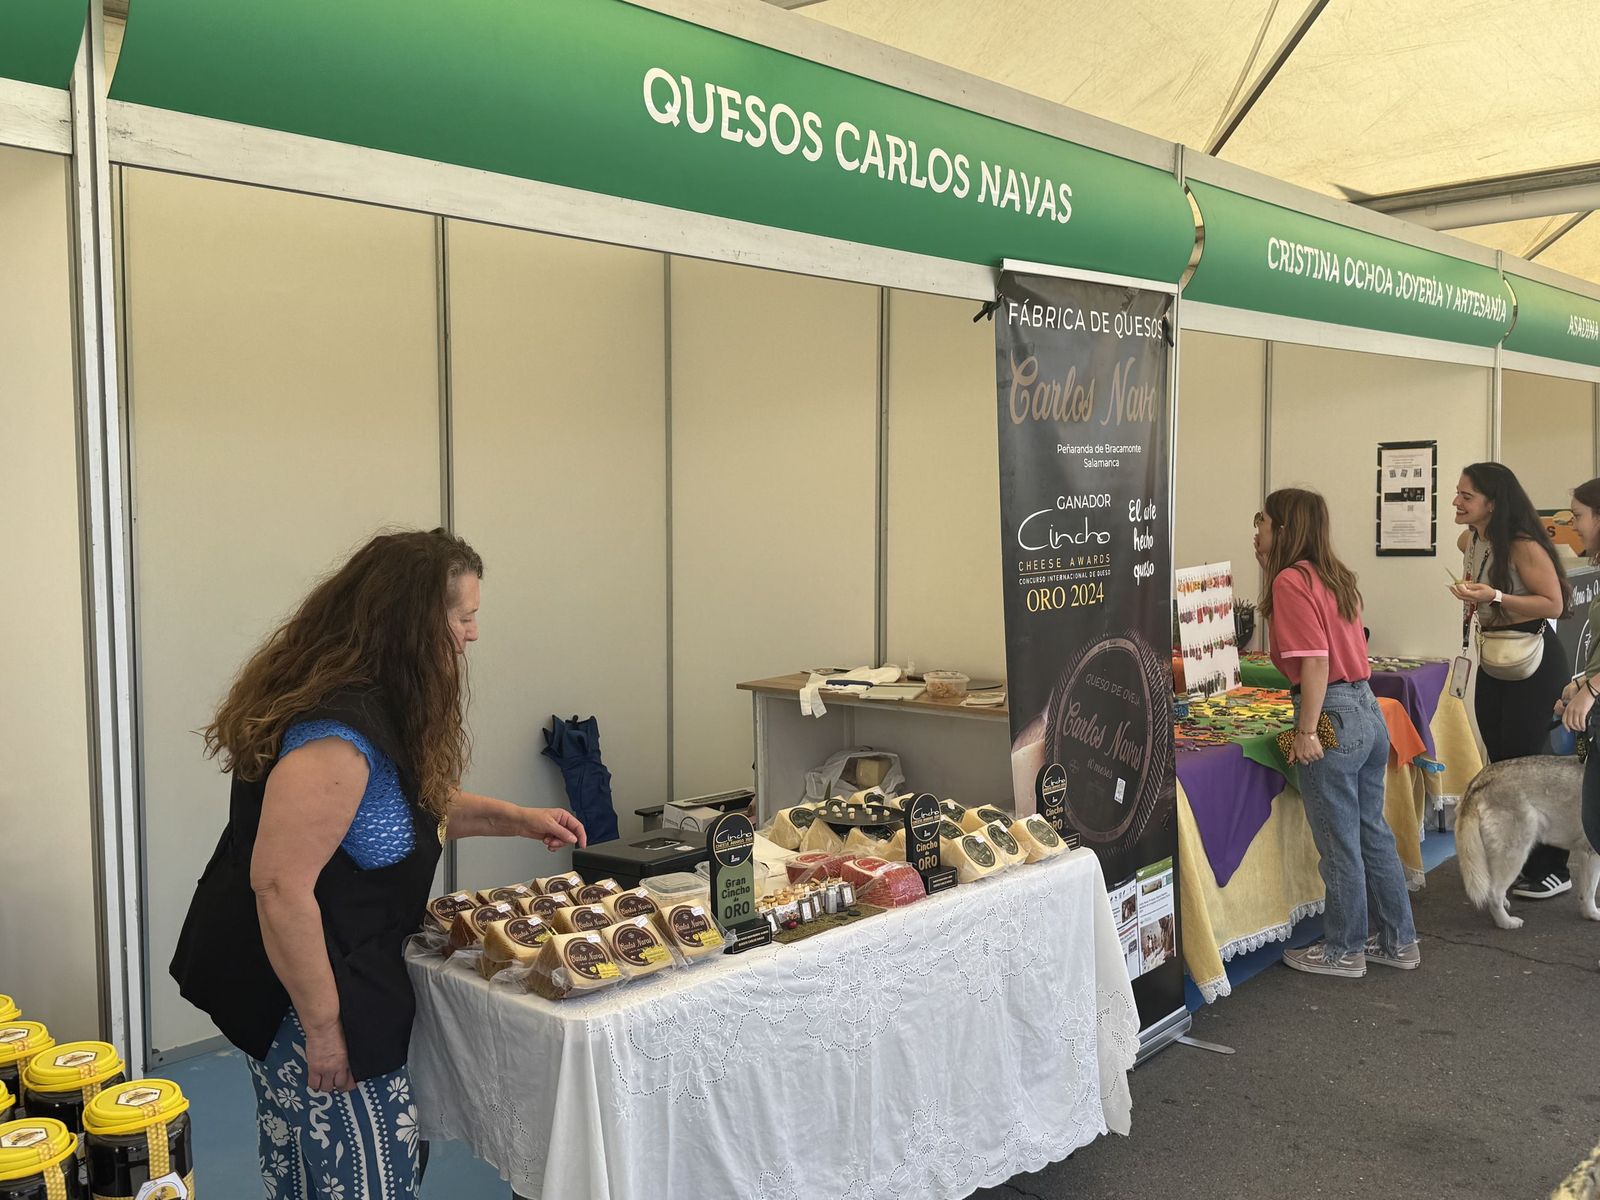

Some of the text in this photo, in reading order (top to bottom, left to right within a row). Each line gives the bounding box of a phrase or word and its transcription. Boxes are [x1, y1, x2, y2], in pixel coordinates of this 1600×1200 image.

[643, 67, 1073, 223] QUESOS CARLOS NAVAS
[1267, 237, 1507, 322] CRISTINA OCHOA JOYERÍA Y ARTESANÍA
[1008, 299, 1163, 340] FÁBRICA DE QUESOS
[1009, 349, 1157, 427] Carlos Nava
[1057, 443, 1142, 455] Peñaranda de Bracamonte
[1084, 458, 1120, 469] Salamanca
[1056, 494, 1111, 510] GANADOR
[1128, 499, 1142, 522] El
[1018, 508, 1111, 551] Cincho
[1133, 526, 1154, 551] hecho
[1018, 553, 1111, 571] CHEESE AWARDS
[1019, 569, 1111, 584] CONCURSO INTERNACIONAL DE QUESO
[1133, 559, 1155, 586] queso
[1026, 581, 1105, 613] ORO 2024
[1085, 673, 1109, 691] QUESO
[1110, 683, 1122, 697] DE
[1062, 696, 1143, 771] Carlos Navas
[912, 808, 939, 820] Cincho
[715, 829, 753, 844] Cincho
[916, 841, 938, 852] Cincho
[919, 855, 937, 870] ORO
[725, 877, 745, 888] Gran
[722, 885, 750, 899] Cincho
[725, 901, 750, 919] ORO
